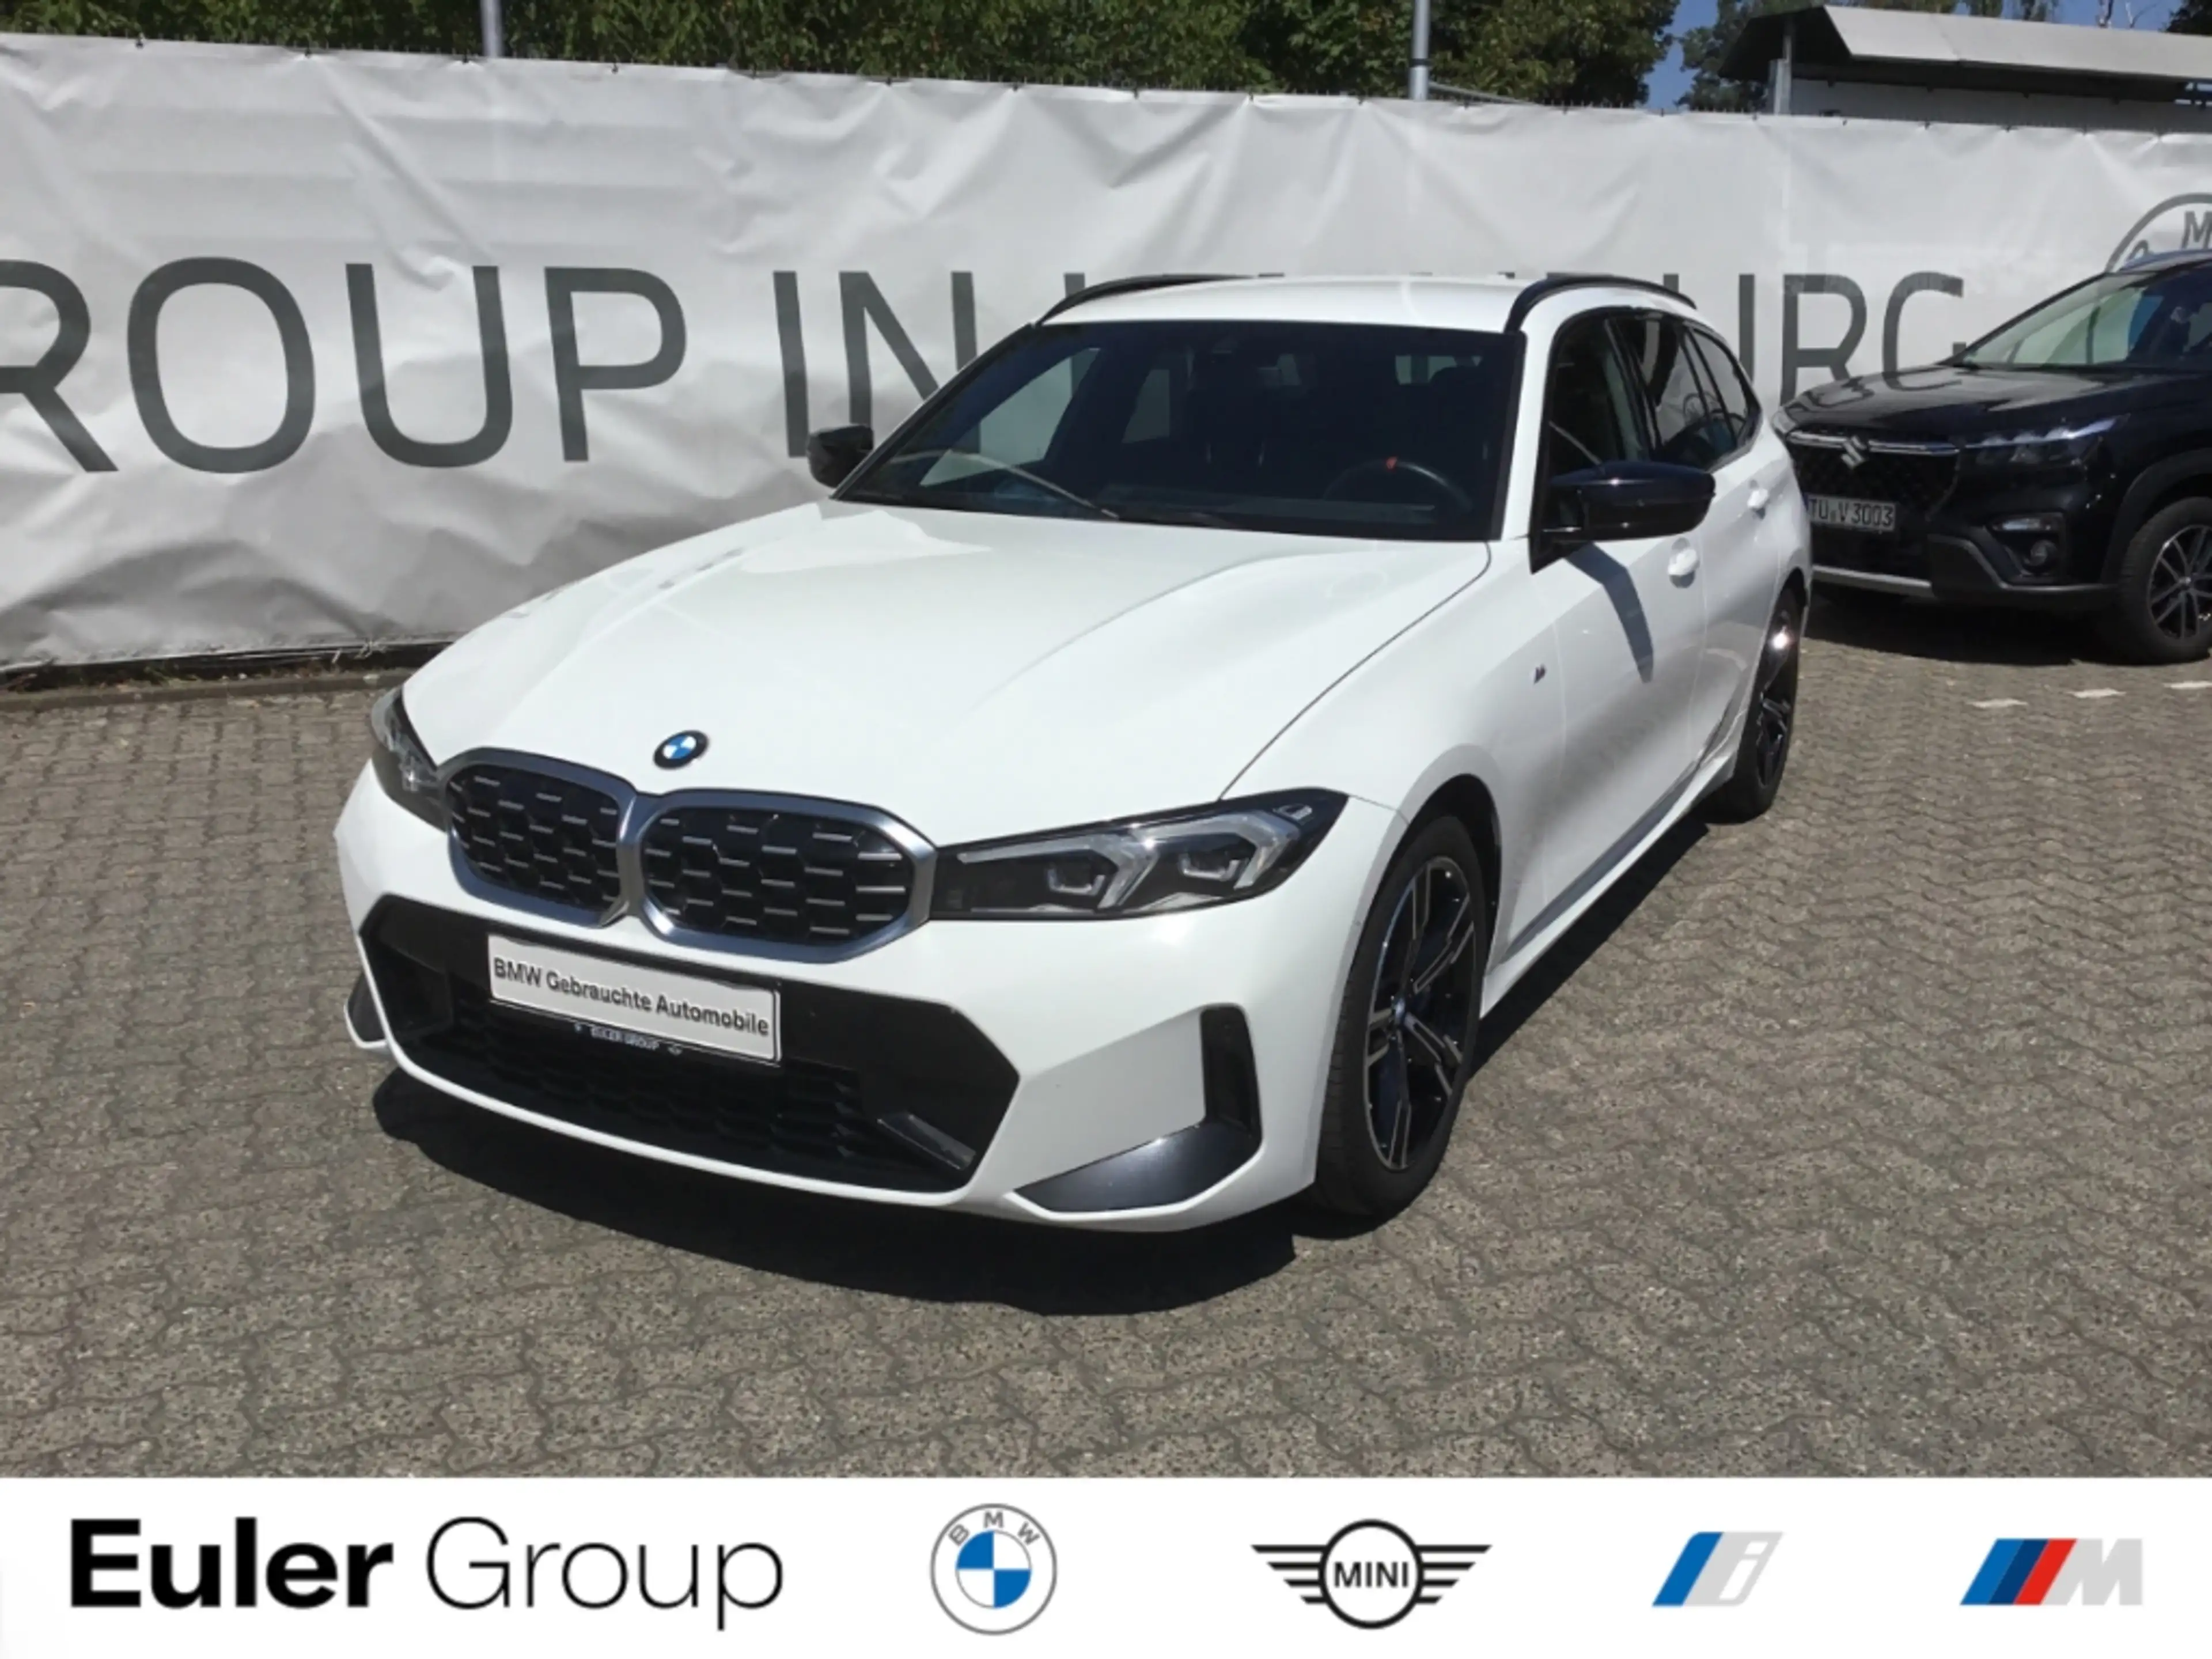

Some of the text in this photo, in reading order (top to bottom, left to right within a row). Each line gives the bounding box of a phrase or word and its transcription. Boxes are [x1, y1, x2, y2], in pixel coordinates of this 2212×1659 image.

[772, 271, 978, 458] IN
[1851, 502, 1894, 527] 3003
[494, 957, 542, 988] BMW
[546, 969, 652, 1012] Gebrauchte
[656, 994, 769, 1036] Automobile
